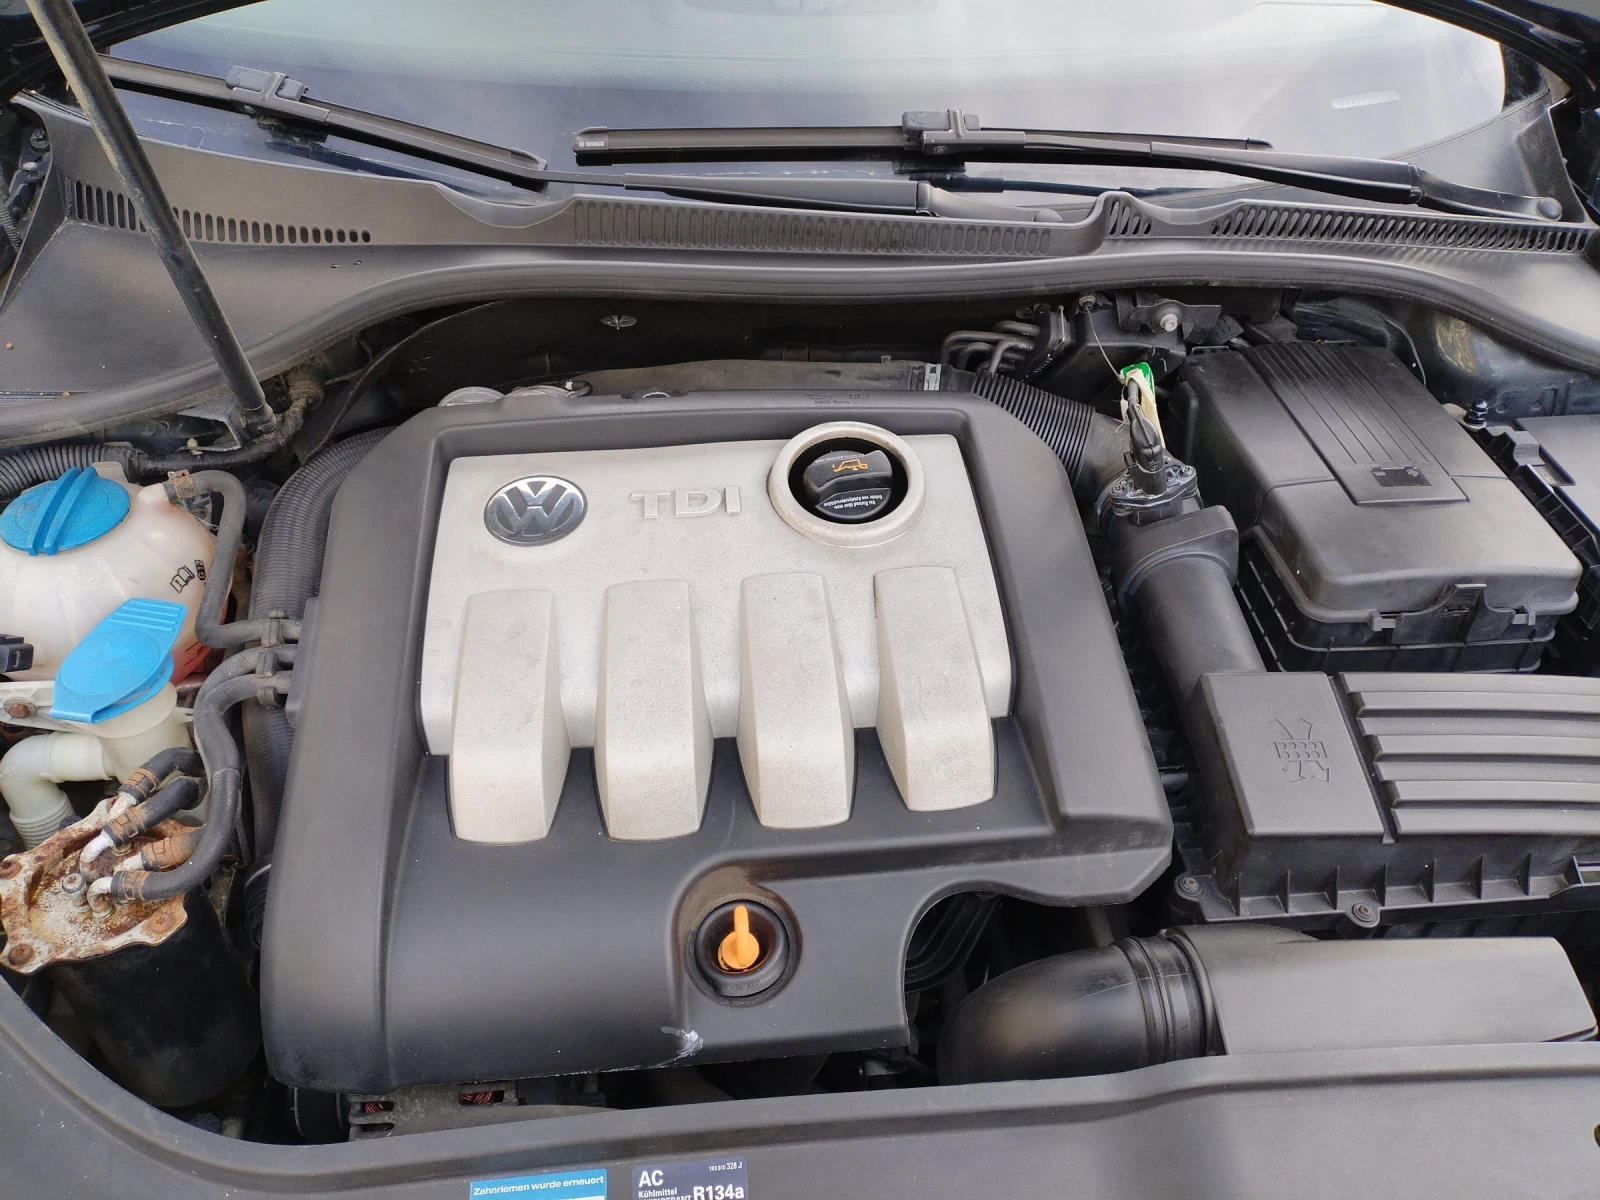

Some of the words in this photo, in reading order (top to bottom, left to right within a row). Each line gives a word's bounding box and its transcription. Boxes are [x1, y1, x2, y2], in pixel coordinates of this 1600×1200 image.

[631, 486, 740, 519] TDI
[473, 1183, 530, 1196] Zahnriemen
[531, 1180, 562, 1190] wurde
[563, 1175, 605, 1187] erneuert
[638, 1169, 664, 1188] AC
[638, 1187, 678, 1199] Kühlmittel
[693, 1184, 745, 1200] R134a
